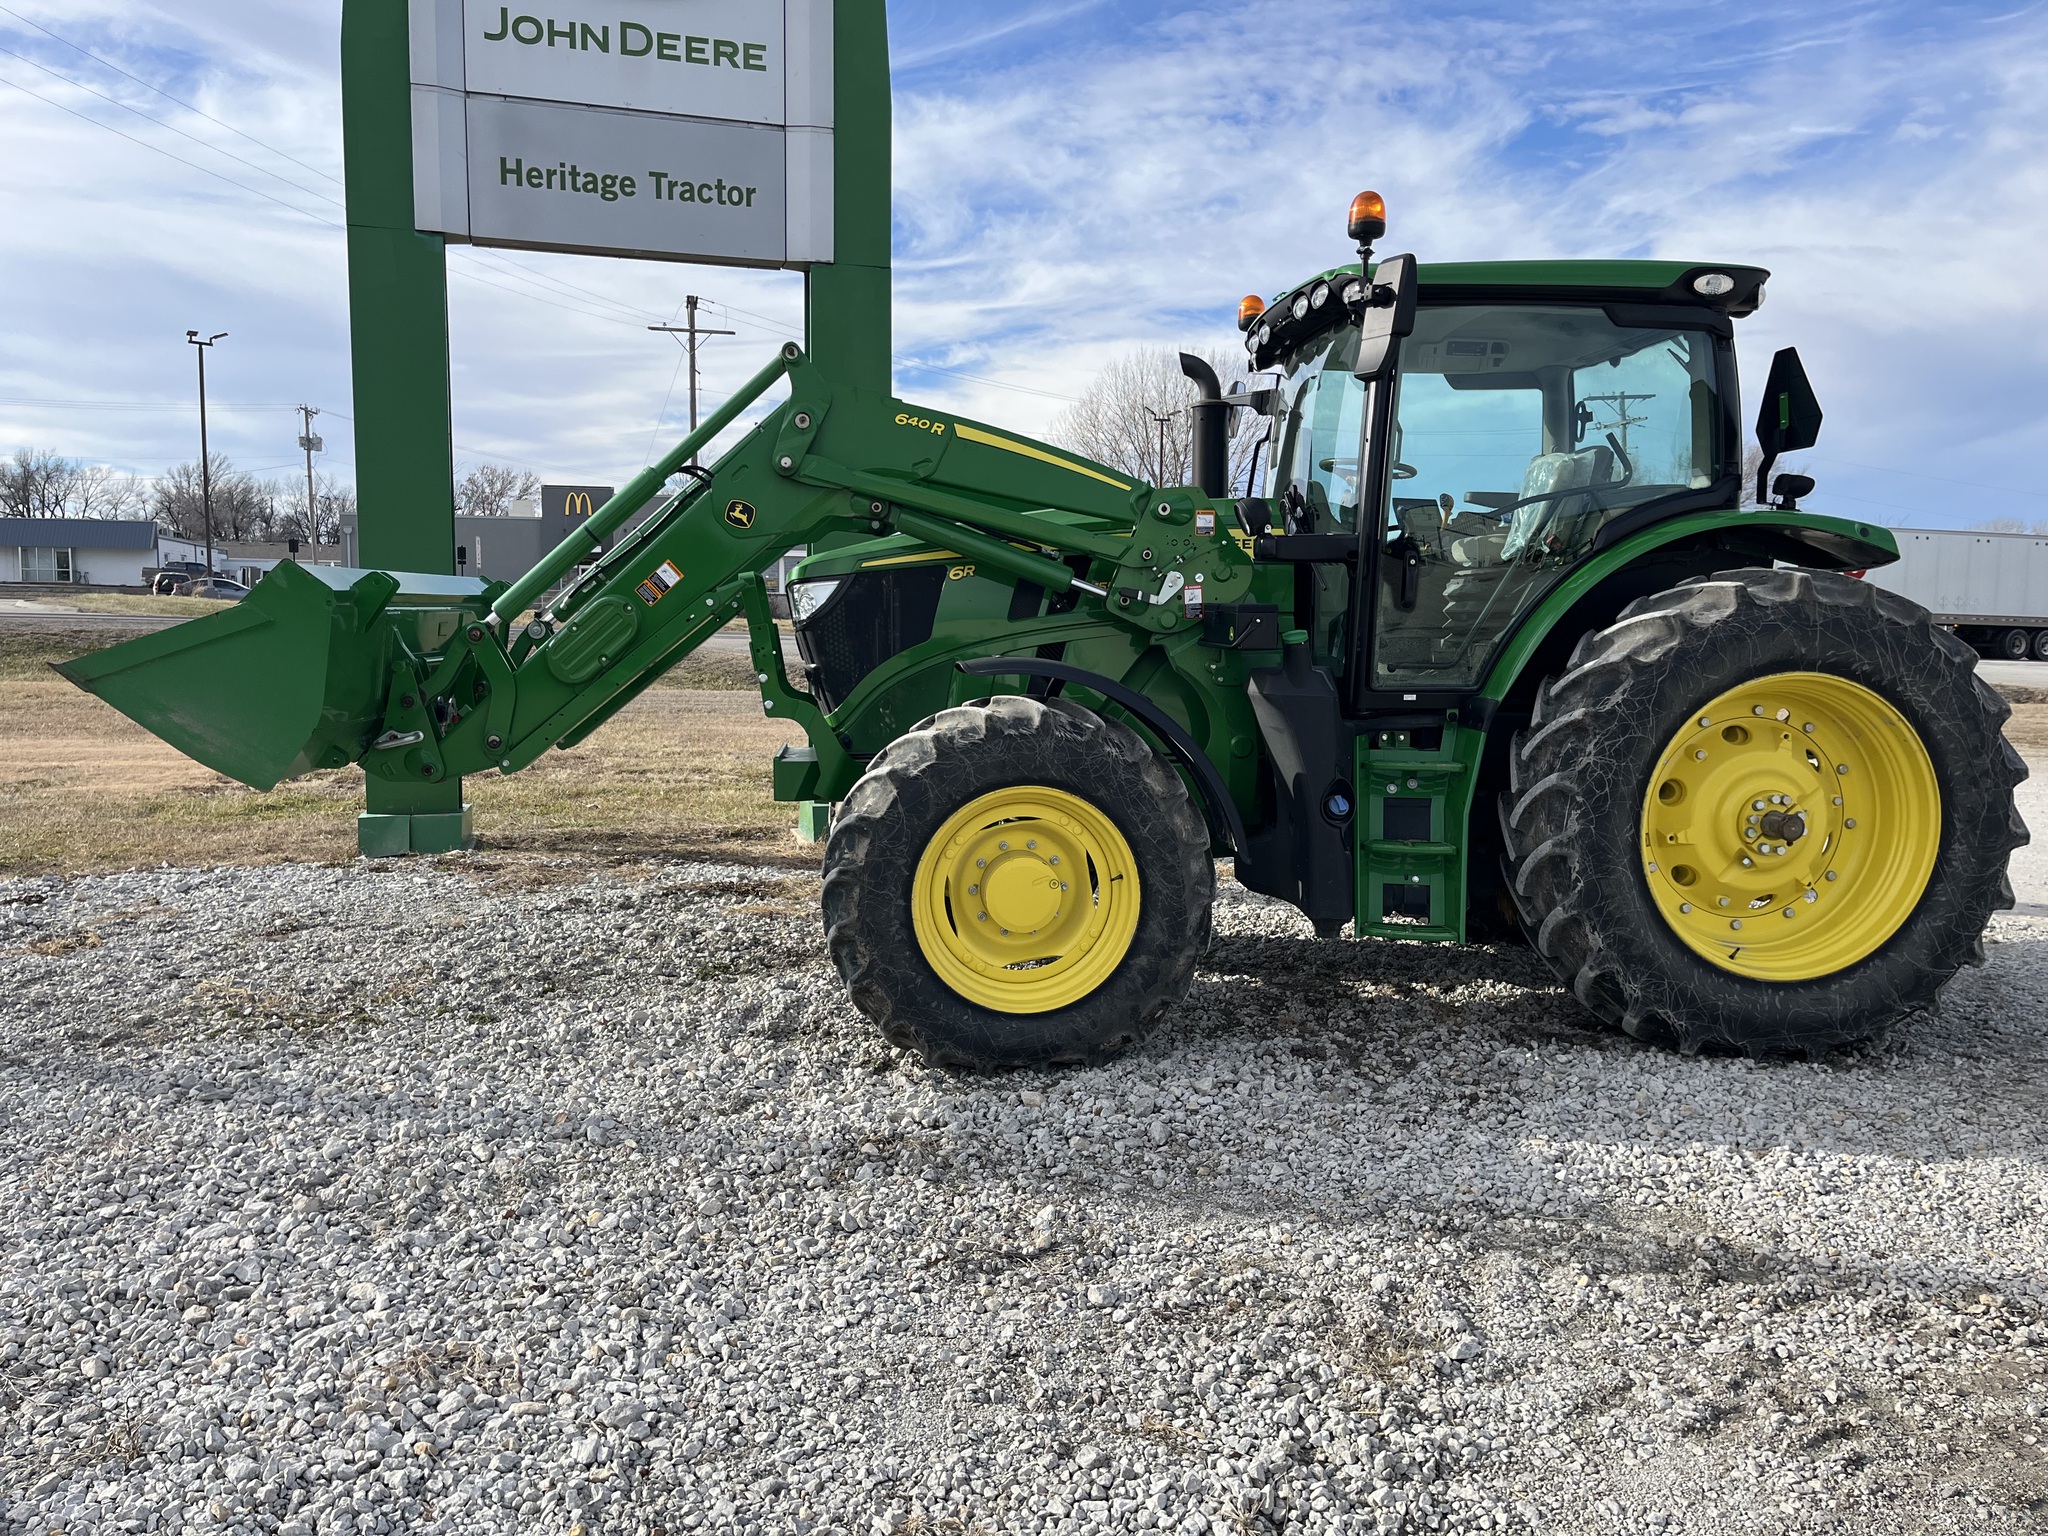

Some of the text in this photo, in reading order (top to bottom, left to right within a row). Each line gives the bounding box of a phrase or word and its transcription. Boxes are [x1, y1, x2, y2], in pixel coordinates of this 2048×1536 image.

[484, 7, 767, 72] JOHN DEERE
[500, 156, 757, 207] Heritage Tractor
[949, 564, 976, 580] 6R
